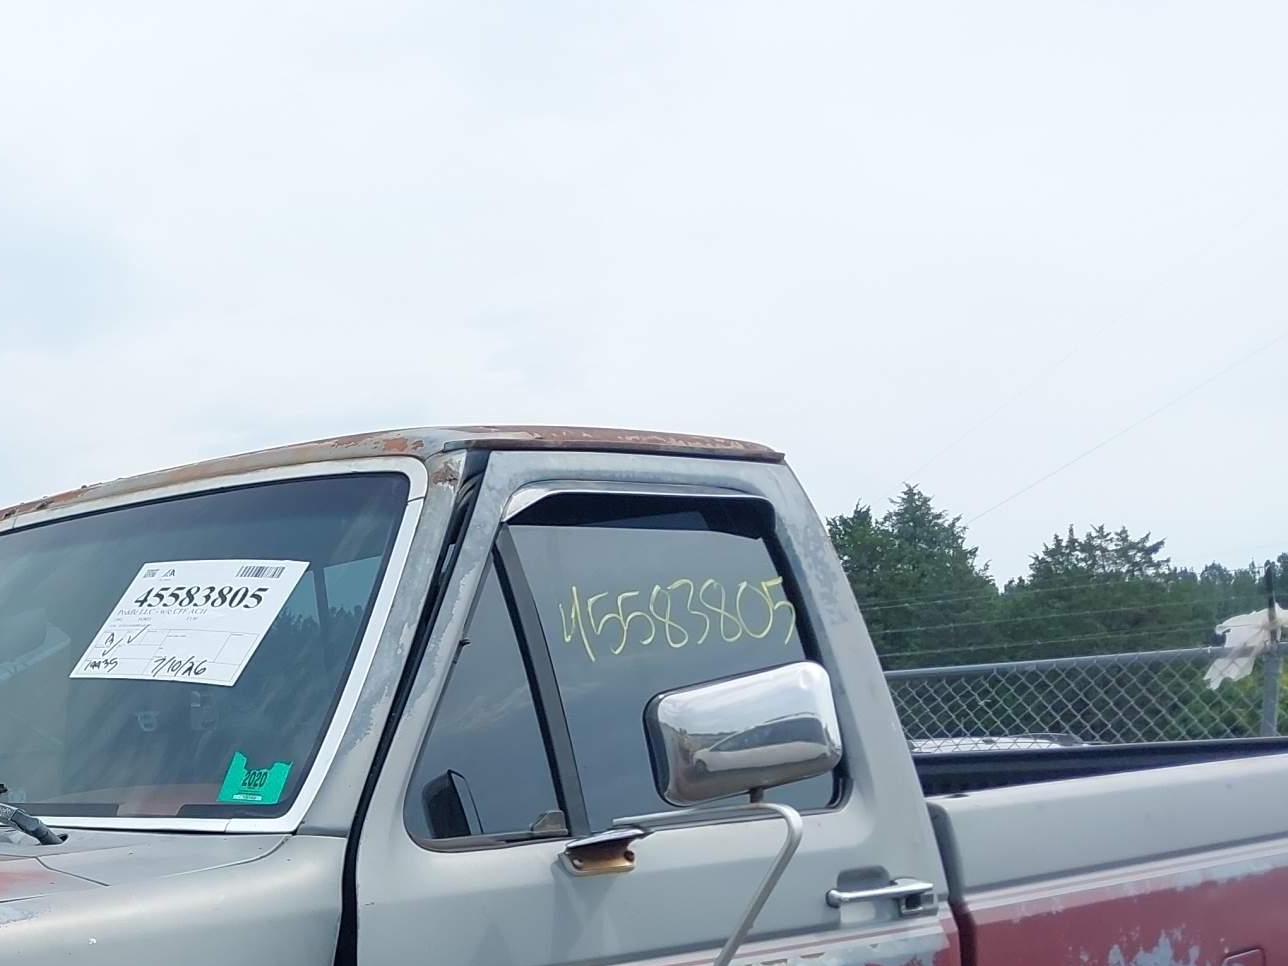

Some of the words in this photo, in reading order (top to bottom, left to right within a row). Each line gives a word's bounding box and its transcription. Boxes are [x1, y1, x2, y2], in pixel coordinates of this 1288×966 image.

[134, 586, 271, 609] 45583805
[559, 577, 797, 662] 45583805
[151, 656, 208, 678] 7/10/26
[241, 770, 268, 788] 2020
